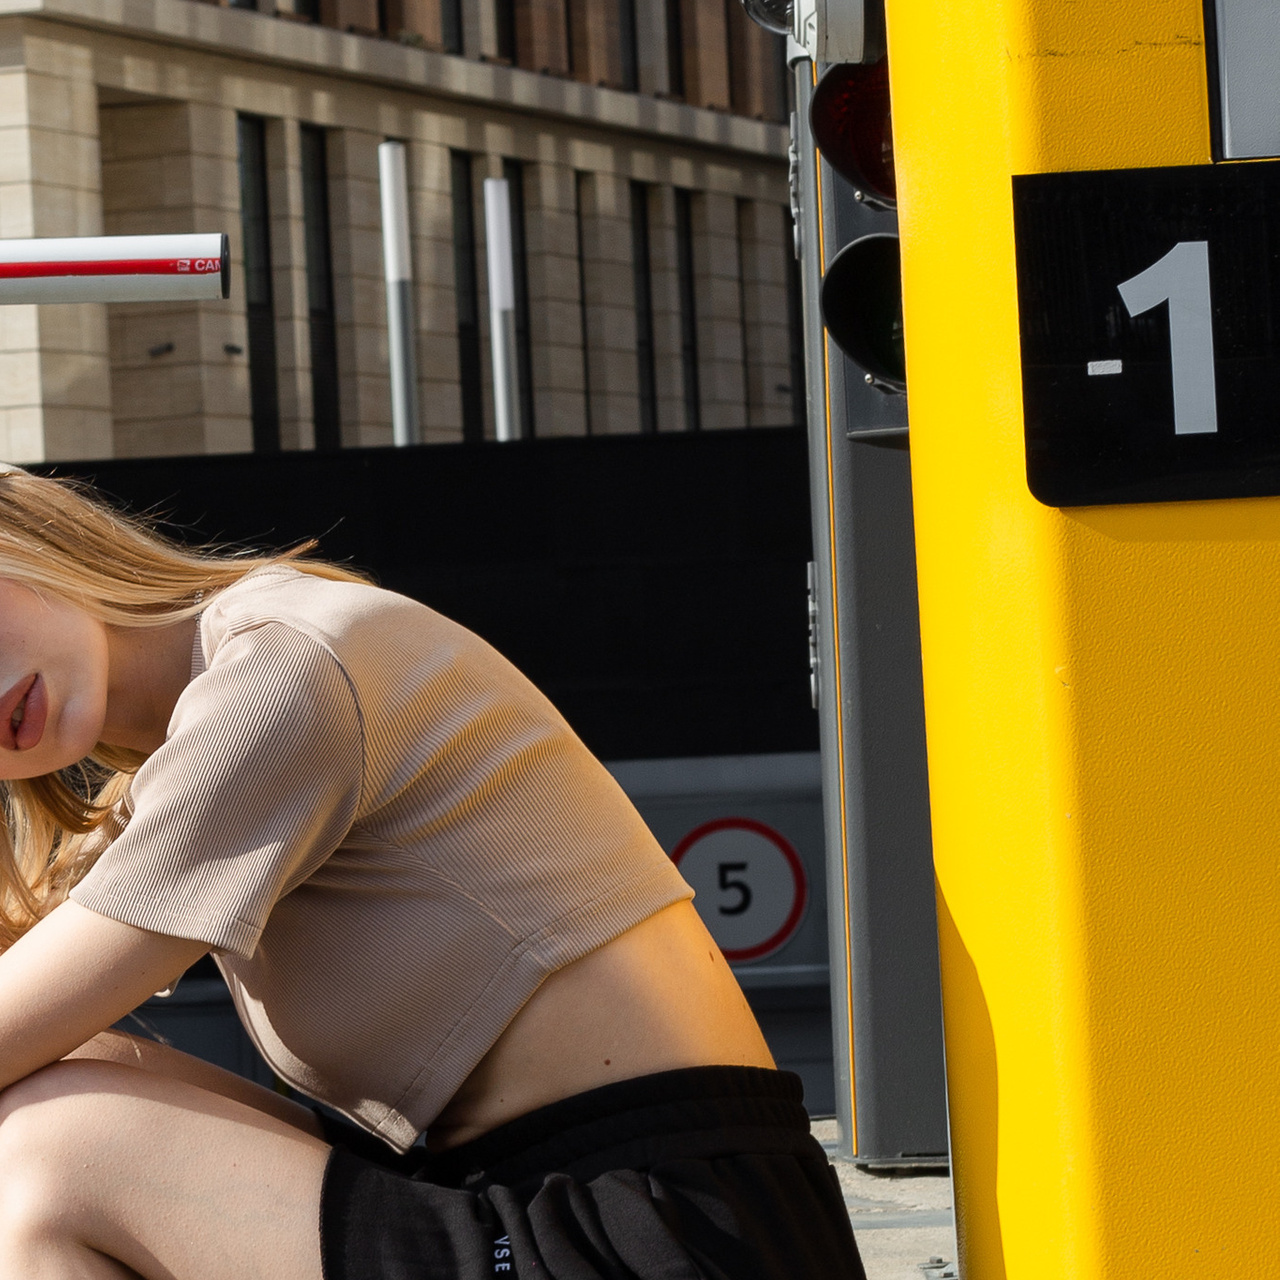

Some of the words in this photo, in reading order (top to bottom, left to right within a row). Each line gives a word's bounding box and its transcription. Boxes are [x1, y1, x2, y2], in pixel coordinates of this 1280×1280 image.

[1087, 240, 1218, 435] -1
[717, 861, 752, 916] 5
[494, 1235, 511, 1272] VSE
